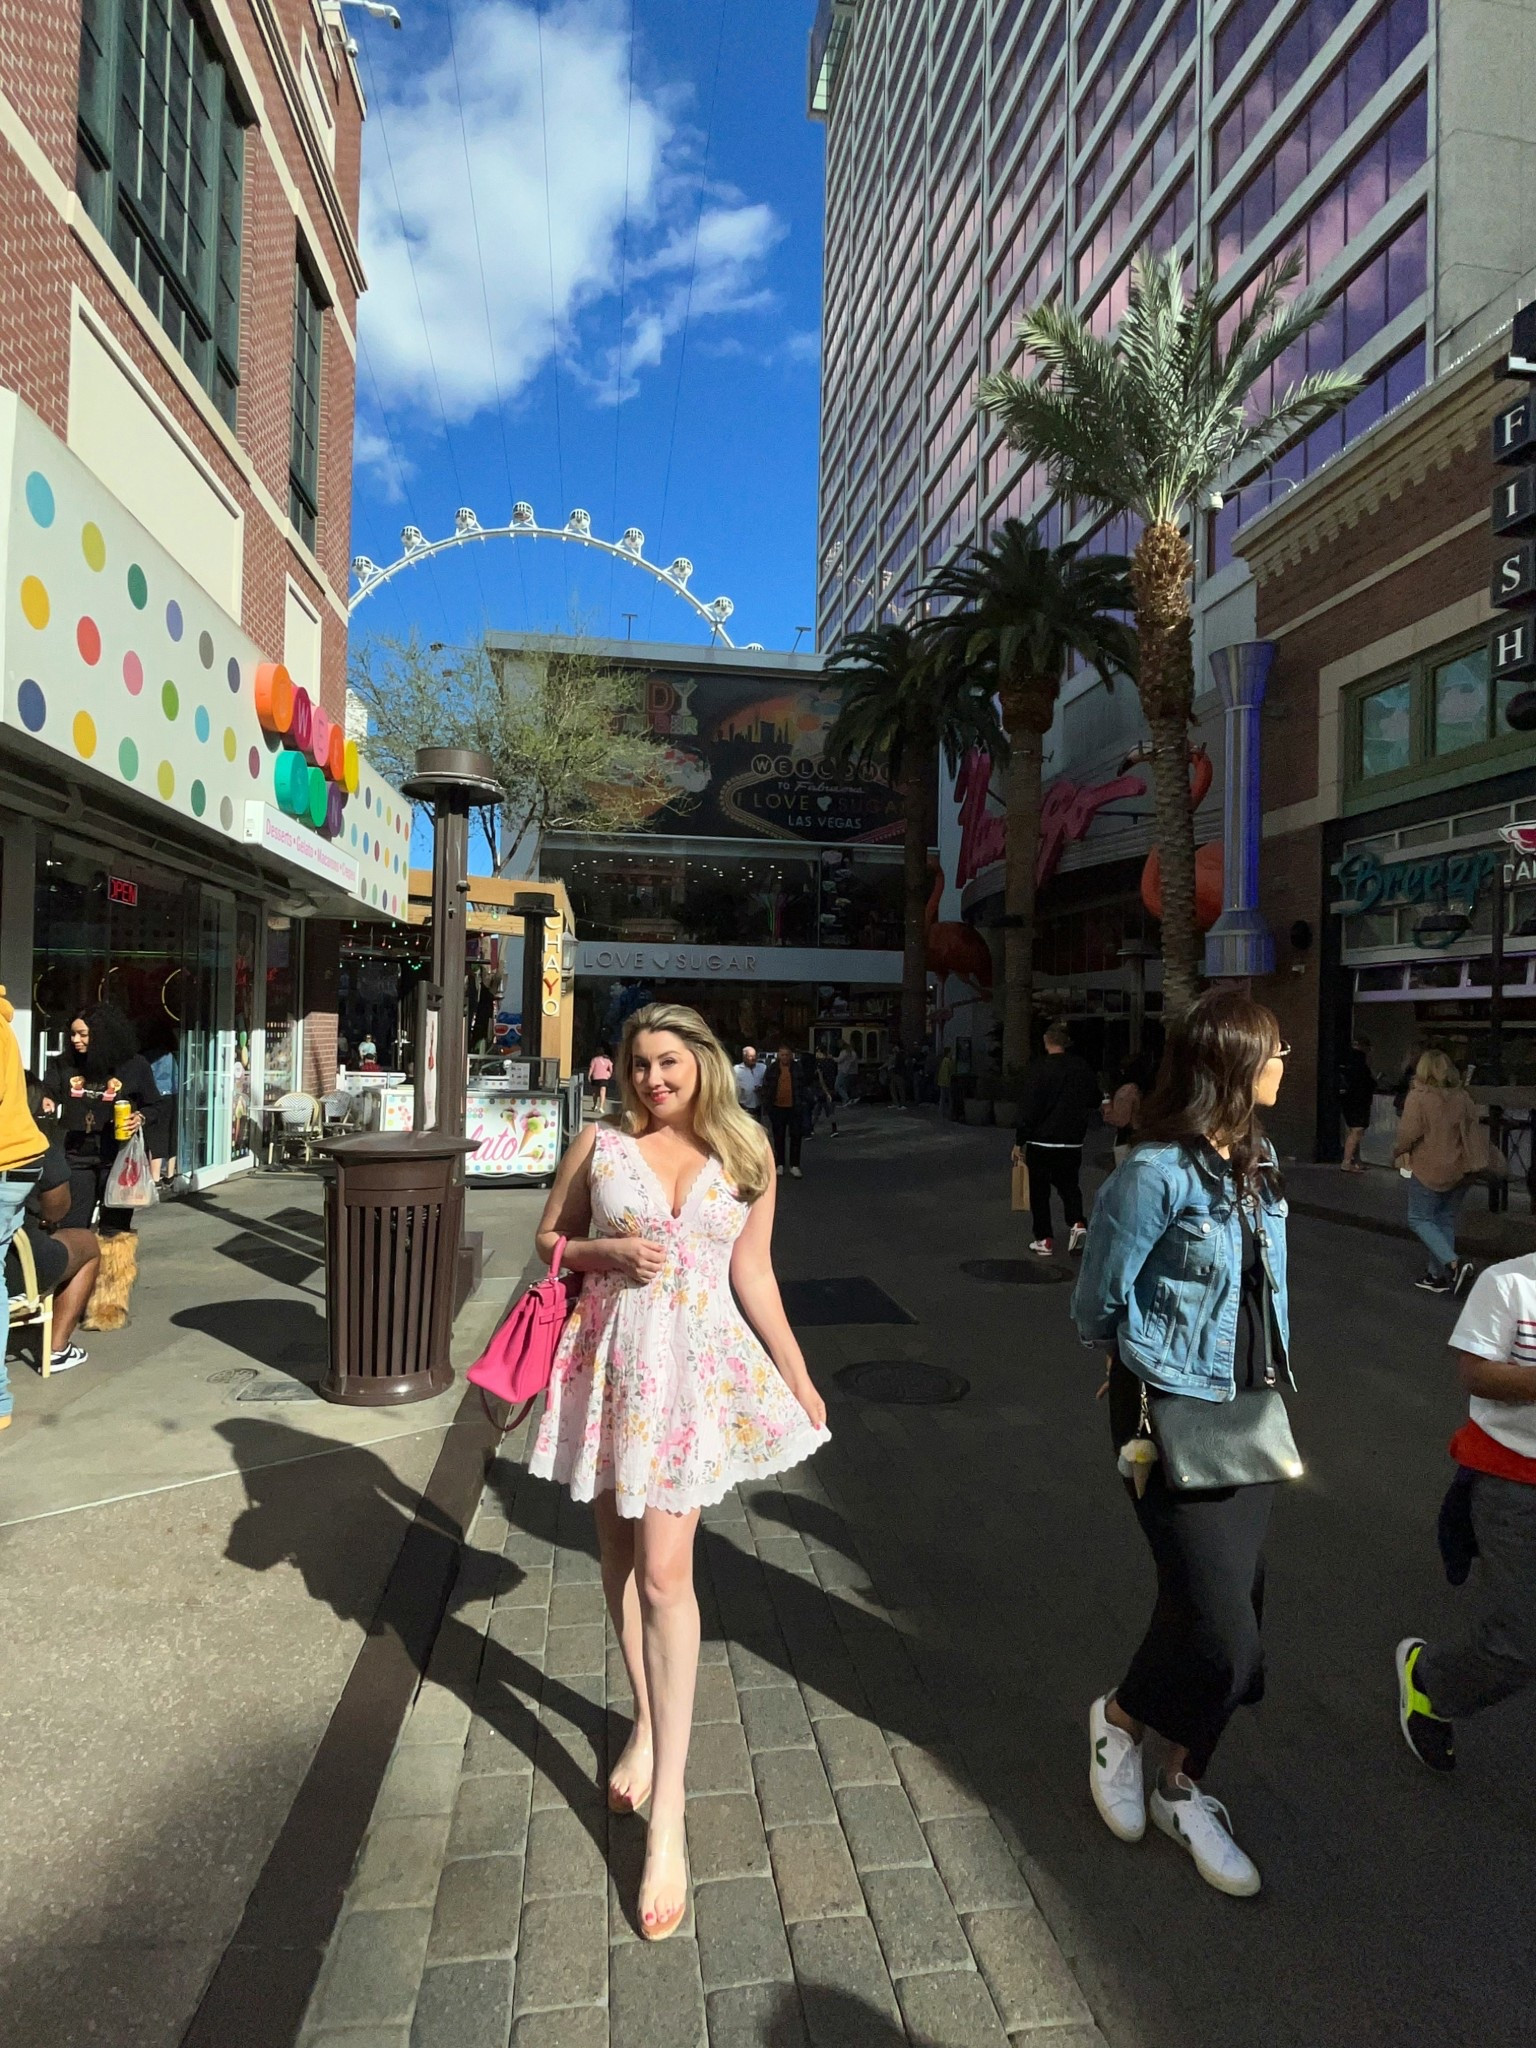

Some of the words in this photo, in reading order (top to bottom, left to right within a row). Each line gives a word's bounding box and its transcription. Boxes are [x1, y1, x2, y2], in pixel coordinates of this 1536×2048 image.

[1496, 405, 1526, 666] FISH
[753, 793, 809, 811] LOVE
[838, 798, 905, 815] SUGA
[266, 818, 293, 847] Desserts
[788, 814, 812, 828] LAS
[817, 817, 862, 830] VEGAS
[1503, 859, 1536, 883] DA
[111, 879, 135, 903] OPEN
[584, 951, 644, 969] LOVE
[676, 954, 757, 972] SUGAR
[466, 1124, 518, 1162] lato
